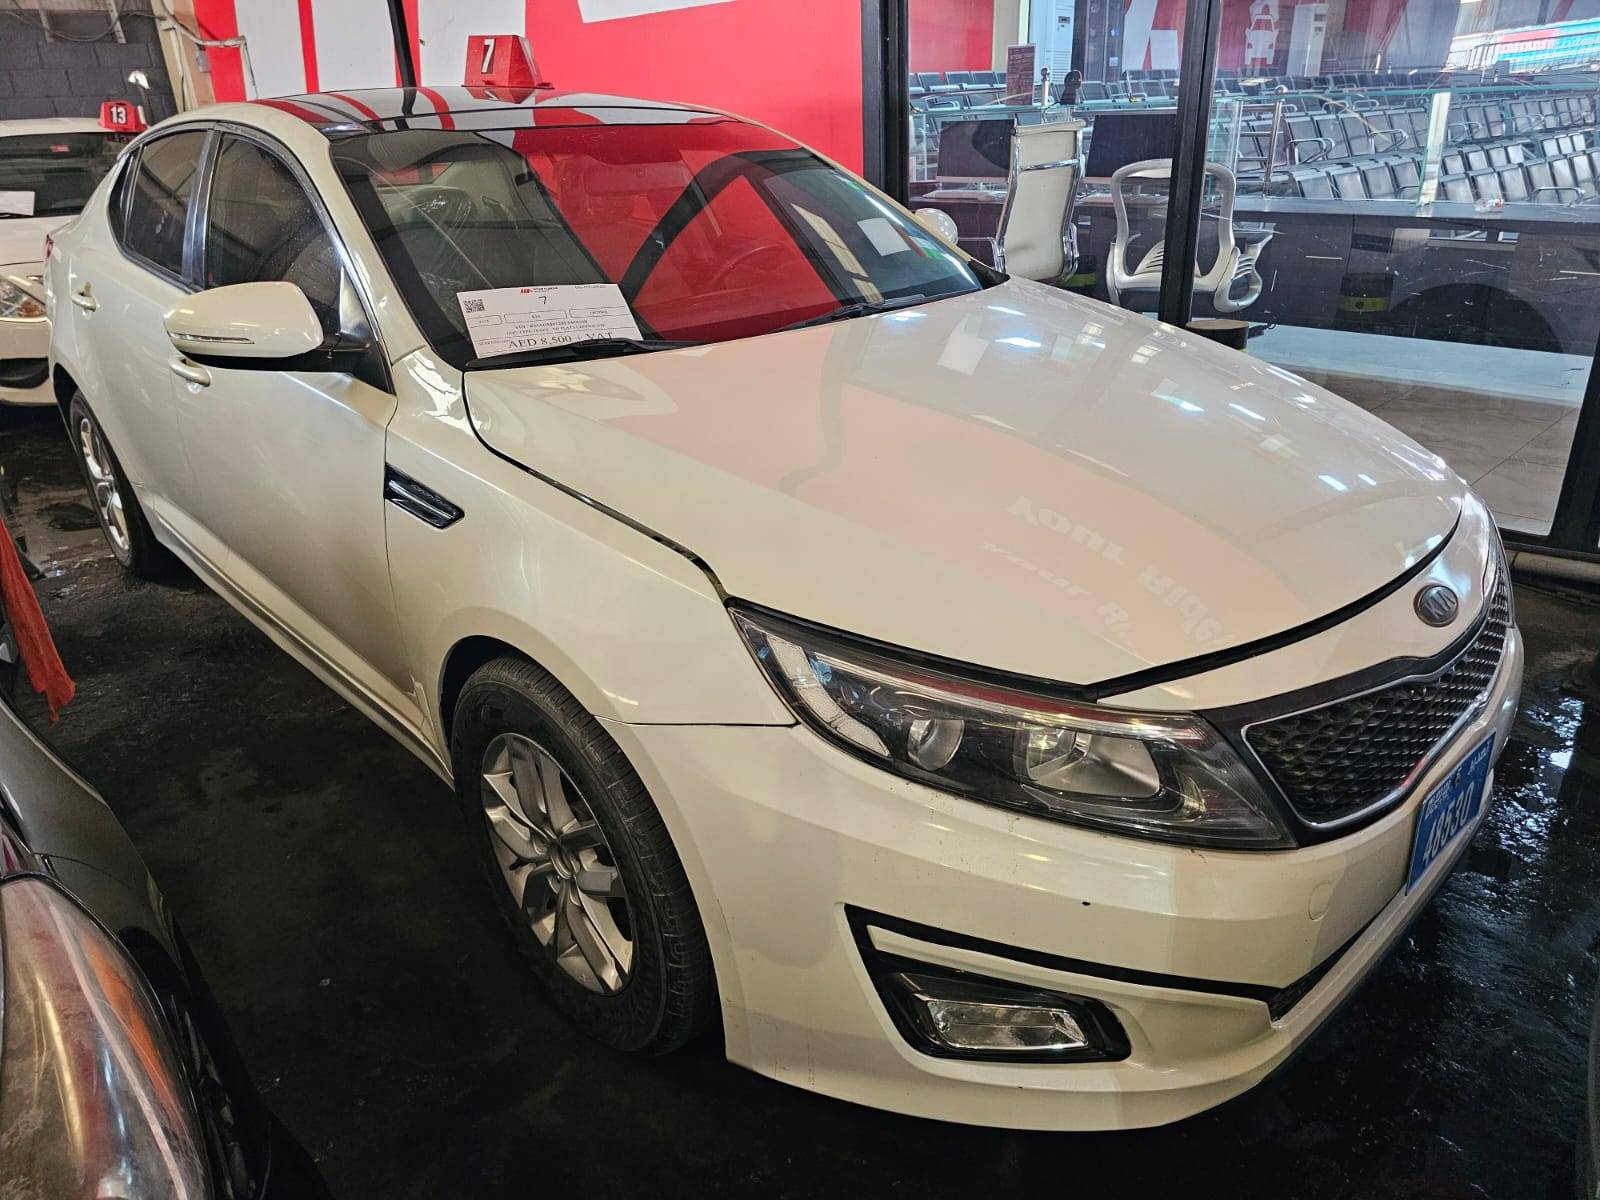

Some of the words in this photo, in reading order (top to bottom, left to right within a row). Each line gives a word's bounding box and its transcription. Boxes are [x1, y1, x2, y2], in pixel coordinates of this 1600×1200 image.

[481, 38, 495, 73] 7
[110, 106, 127, 124] 13
[538, 295, 547, 305] 7
[509, 338, 537, 348] AED
[585, 331, 613, 340] VAT
[1424, 589, 1456, 619] KIA
[1422, 781, 1475, 865] 48530
